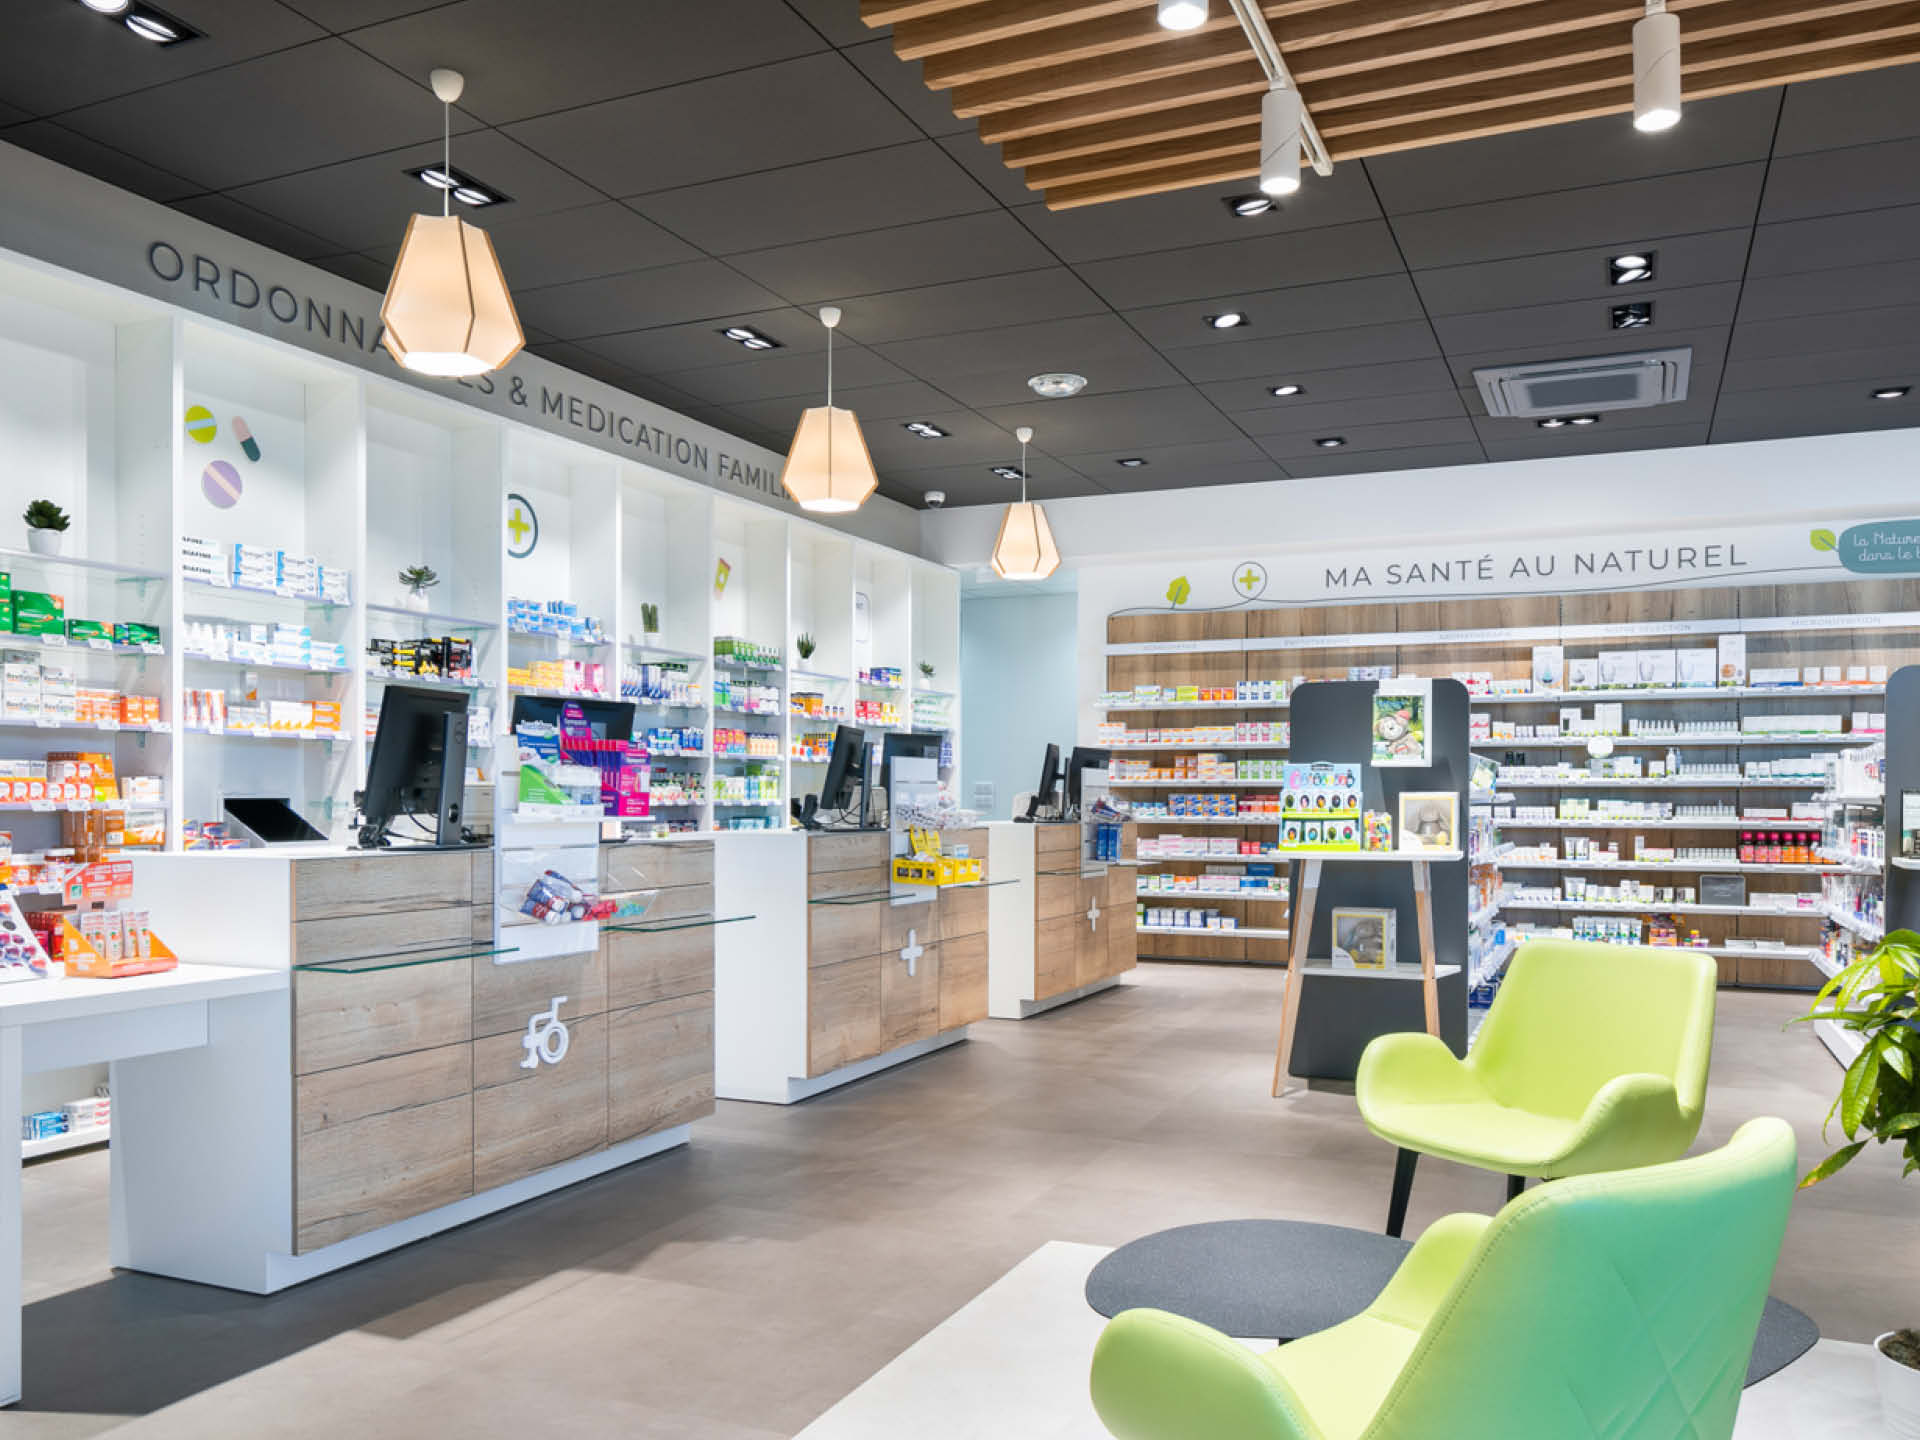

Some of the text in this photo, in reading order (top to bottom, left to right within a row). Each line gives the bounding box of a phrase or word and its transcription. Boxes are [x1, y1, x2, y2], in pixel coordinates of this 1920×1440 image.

[510, 375, 528, 408] &
[541, 384, 709, 471] MEDICATION
[1325, 543, 1748, 589] MA SANTÉ AU NATUREL
